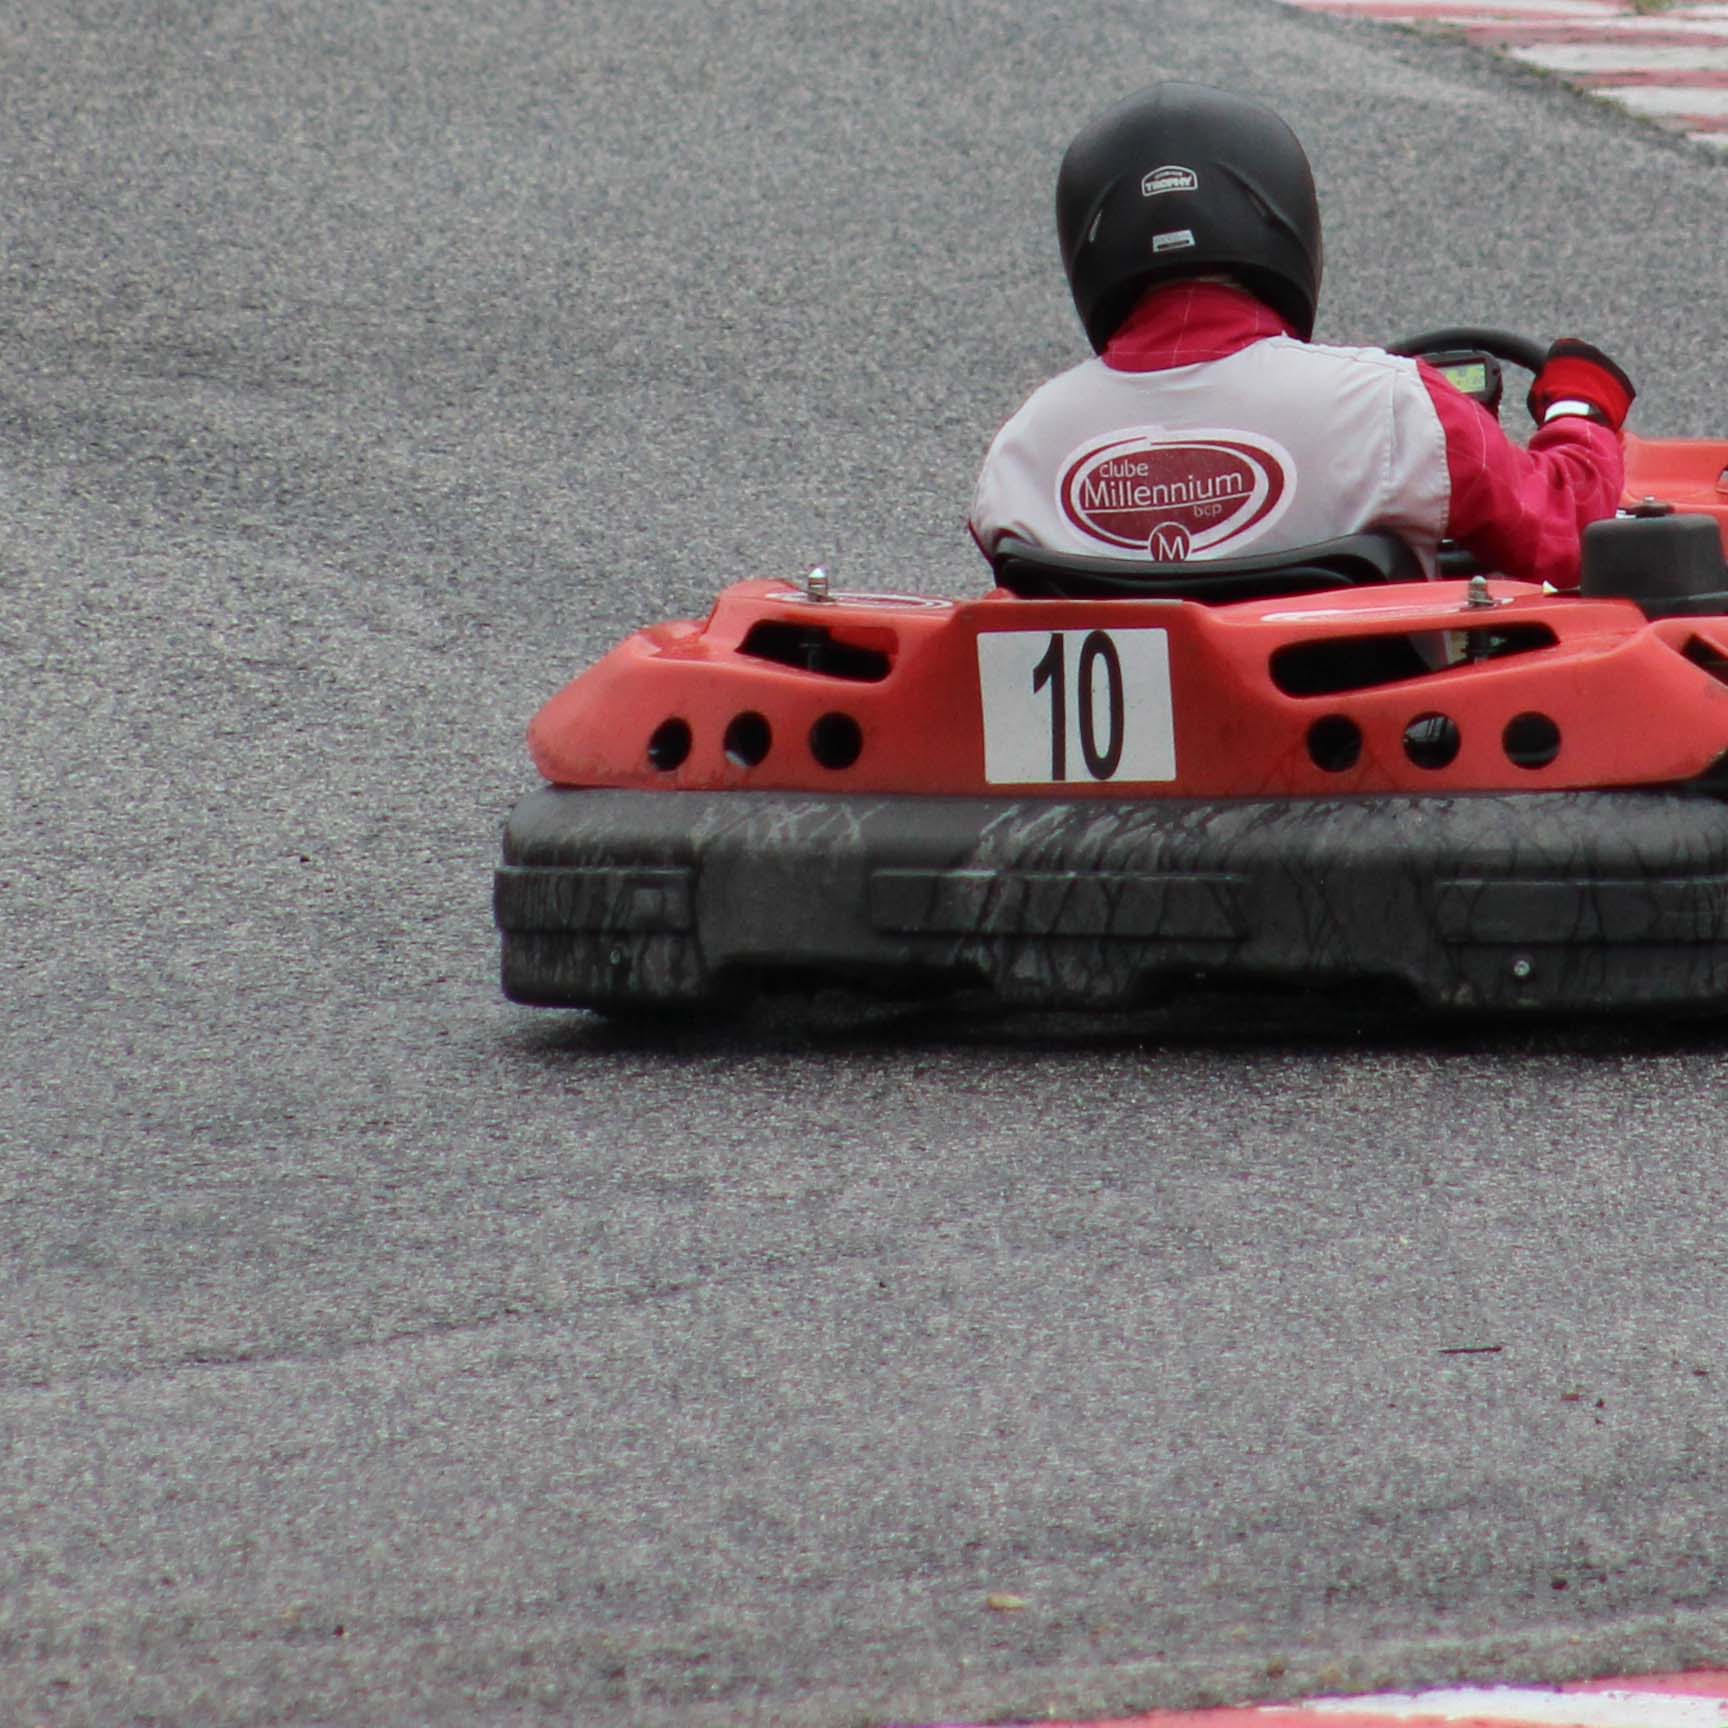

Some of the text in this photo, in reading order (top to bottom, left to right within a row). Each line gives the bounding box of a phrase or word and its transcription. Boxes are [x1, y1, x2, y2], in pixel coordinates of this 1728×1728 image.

[1099, 460, 1149, 478] clube
[1084, 472, 1243, 508] Millennium
[1033, 630, 1124, 781] 10
